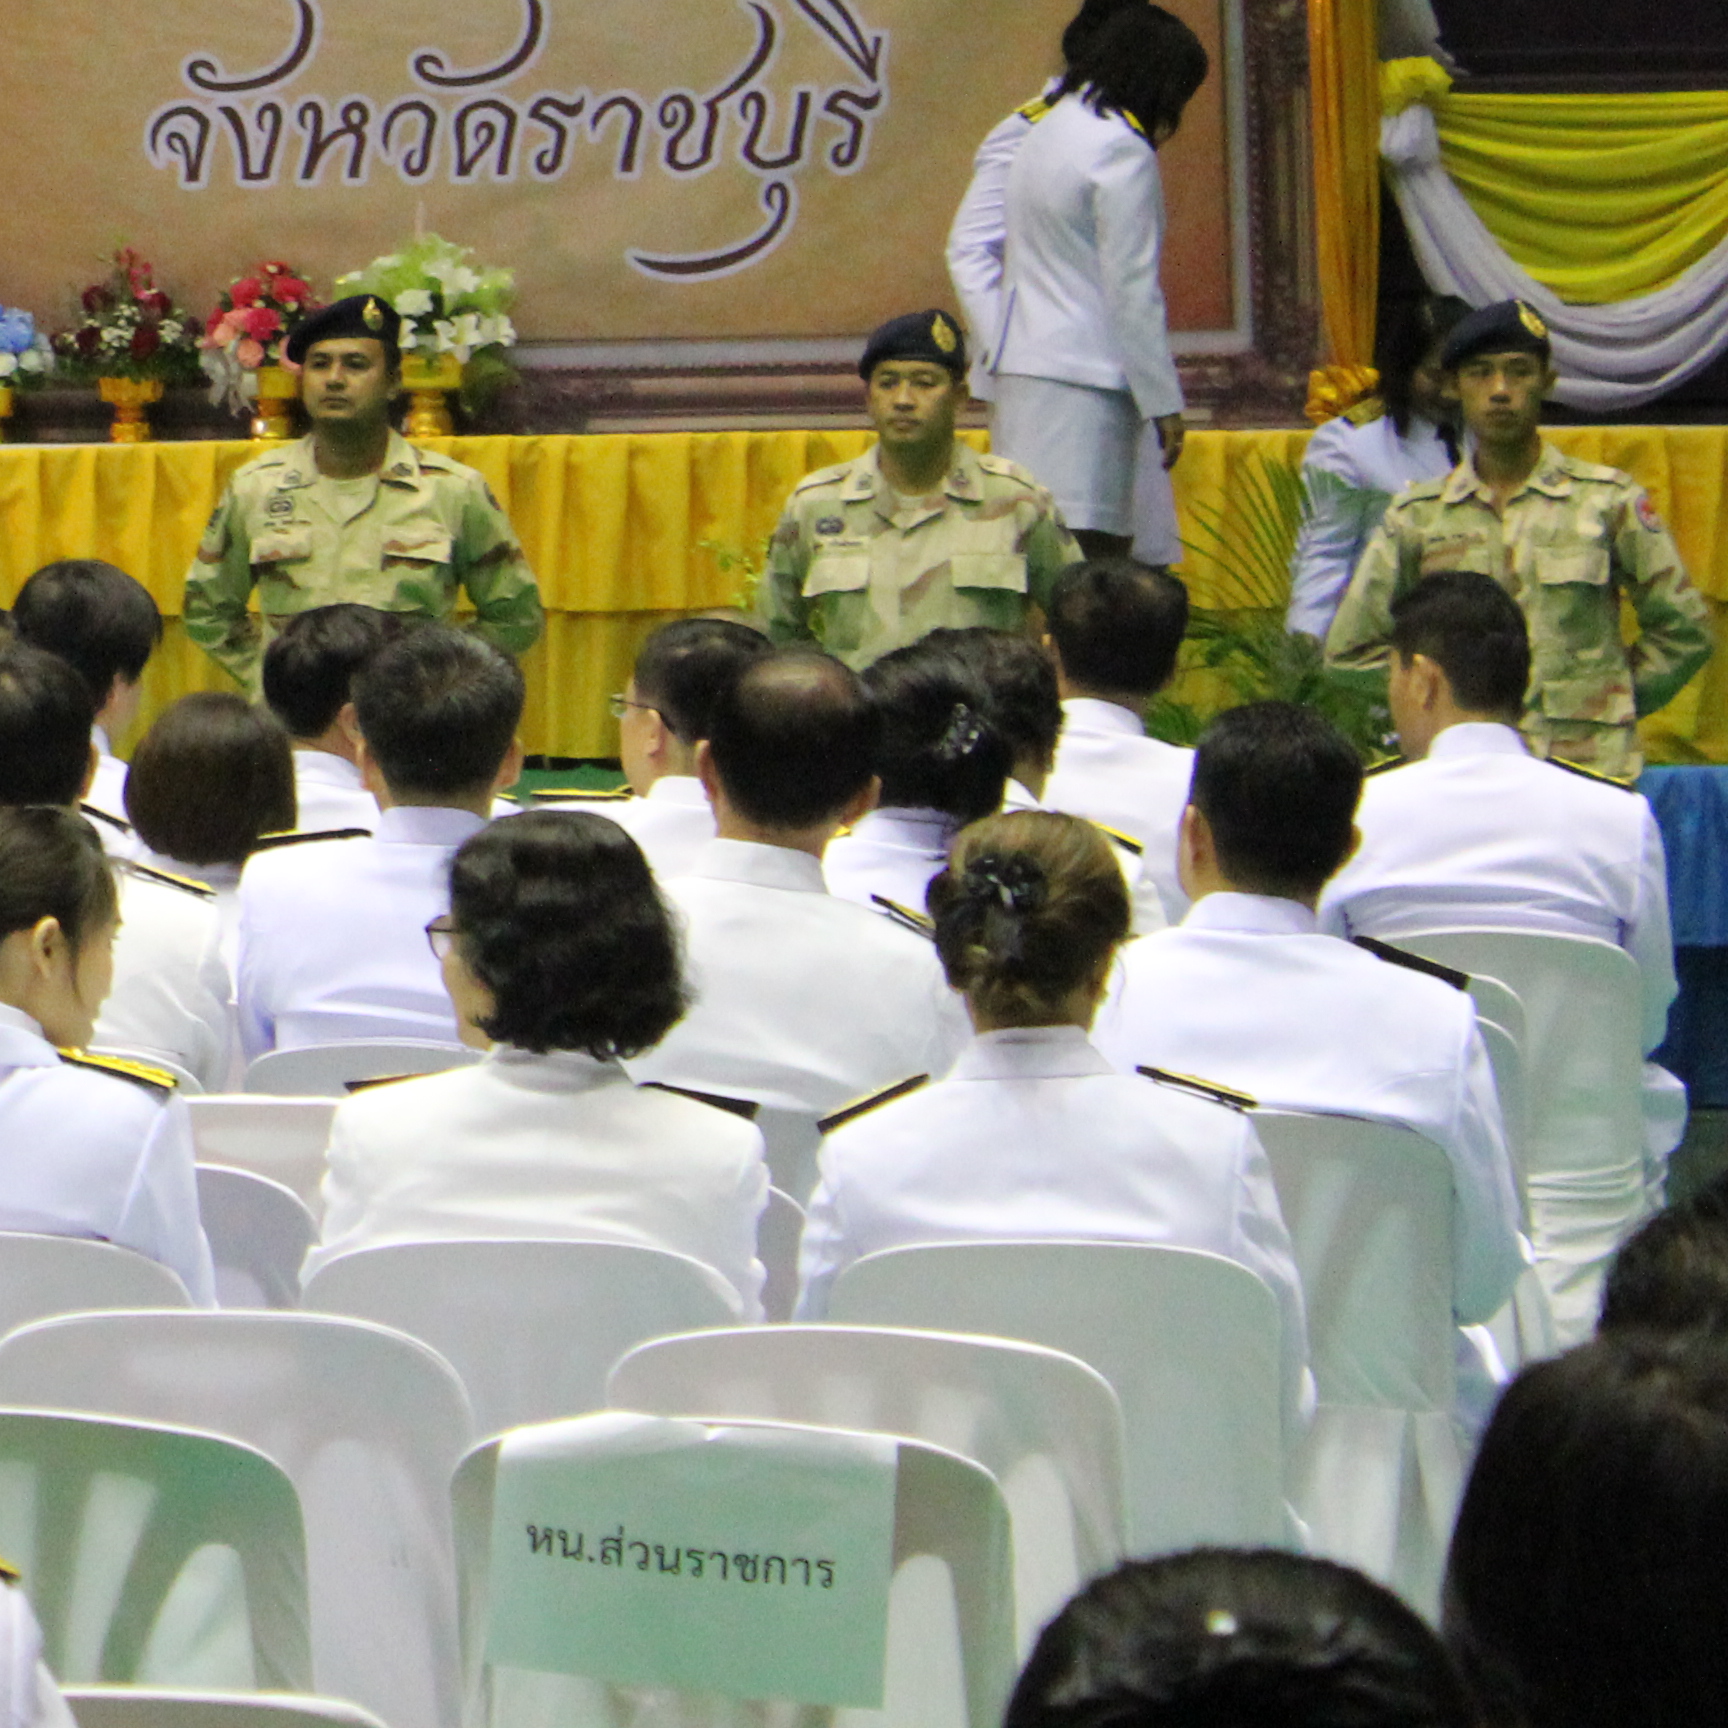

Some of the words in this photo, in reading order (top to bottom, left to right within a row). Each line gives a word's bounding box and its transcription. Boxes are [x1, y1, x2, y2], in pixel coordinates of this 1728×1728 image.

[526, 1523, 836, 1589] หน.ส่วนราชการ
